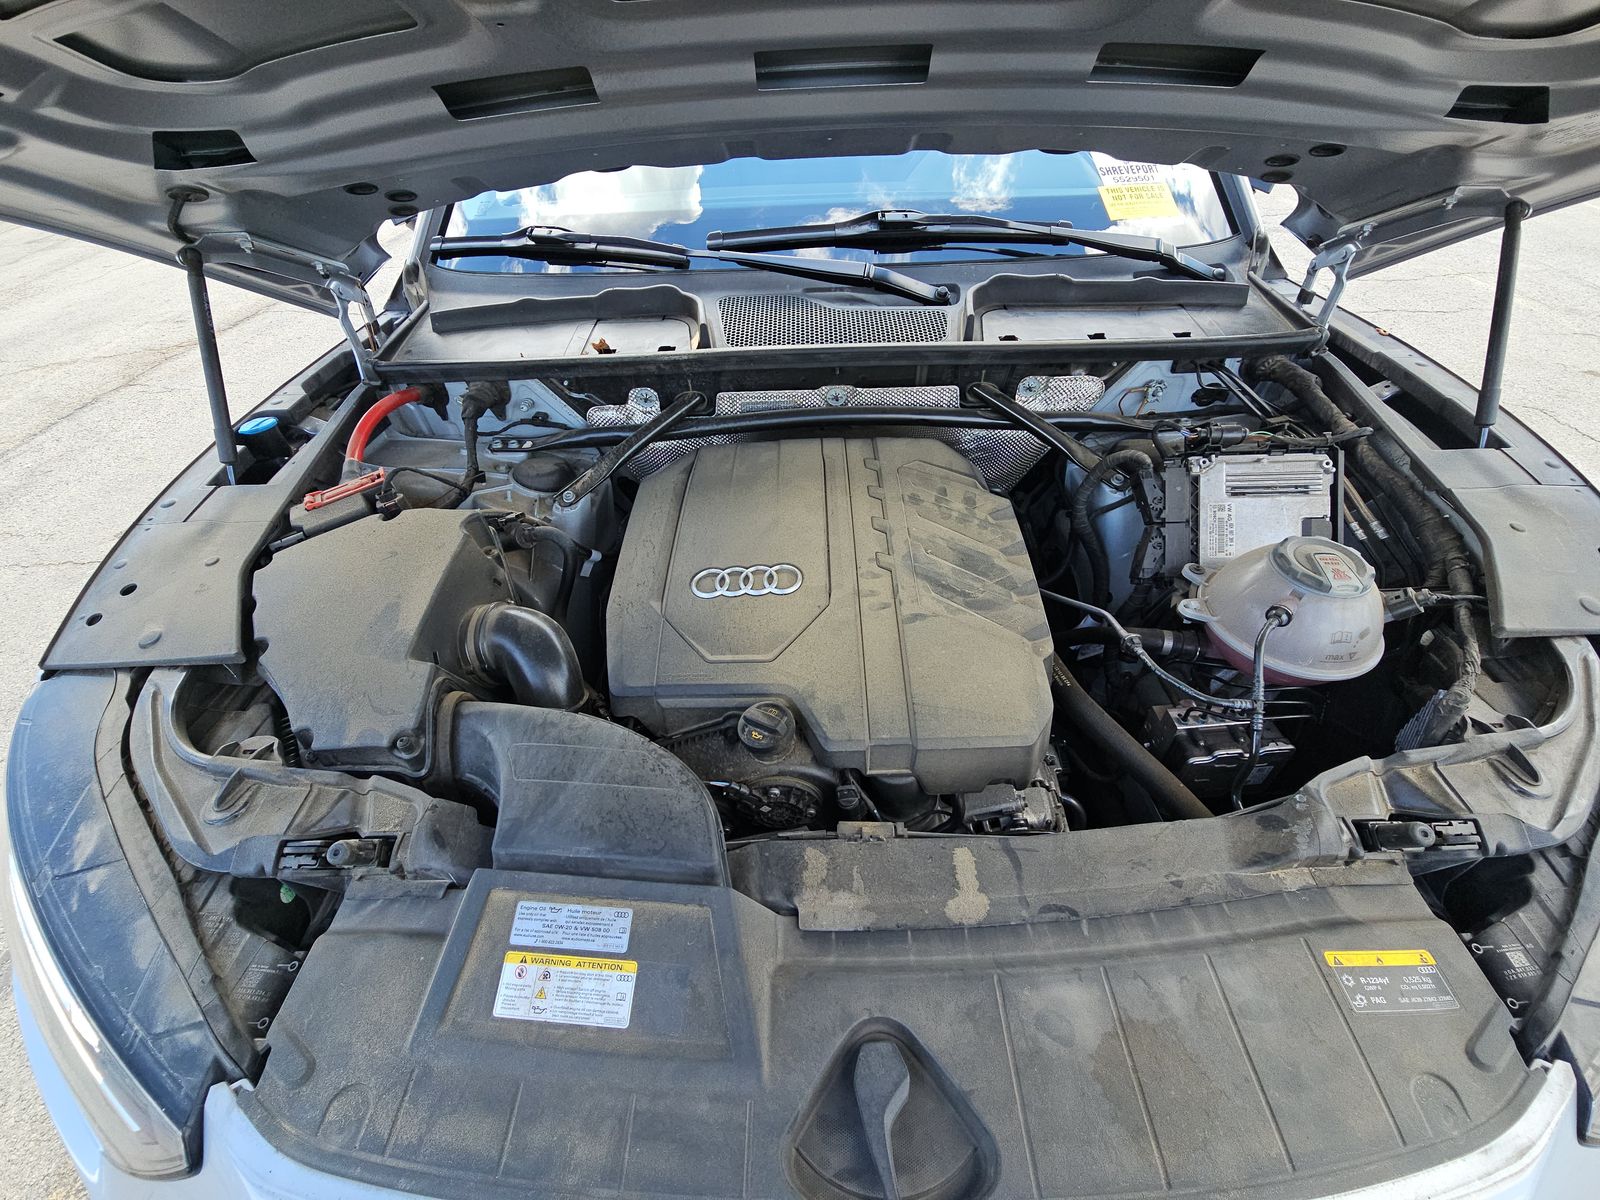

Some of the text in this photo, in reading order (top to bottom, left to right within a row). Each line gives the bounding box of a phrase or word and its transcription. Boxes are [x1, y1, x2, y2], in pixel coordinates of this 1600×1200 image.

[1099, 164, 1159, 176] SHREVEPORT
[1112, 175, 1155, 184] 5529501
[530, 957, 624, 971] WARNING ATTENTION
[1360, 976, 1390, 985] R-1234yf
[1421, 976, 1433, 984] kg
